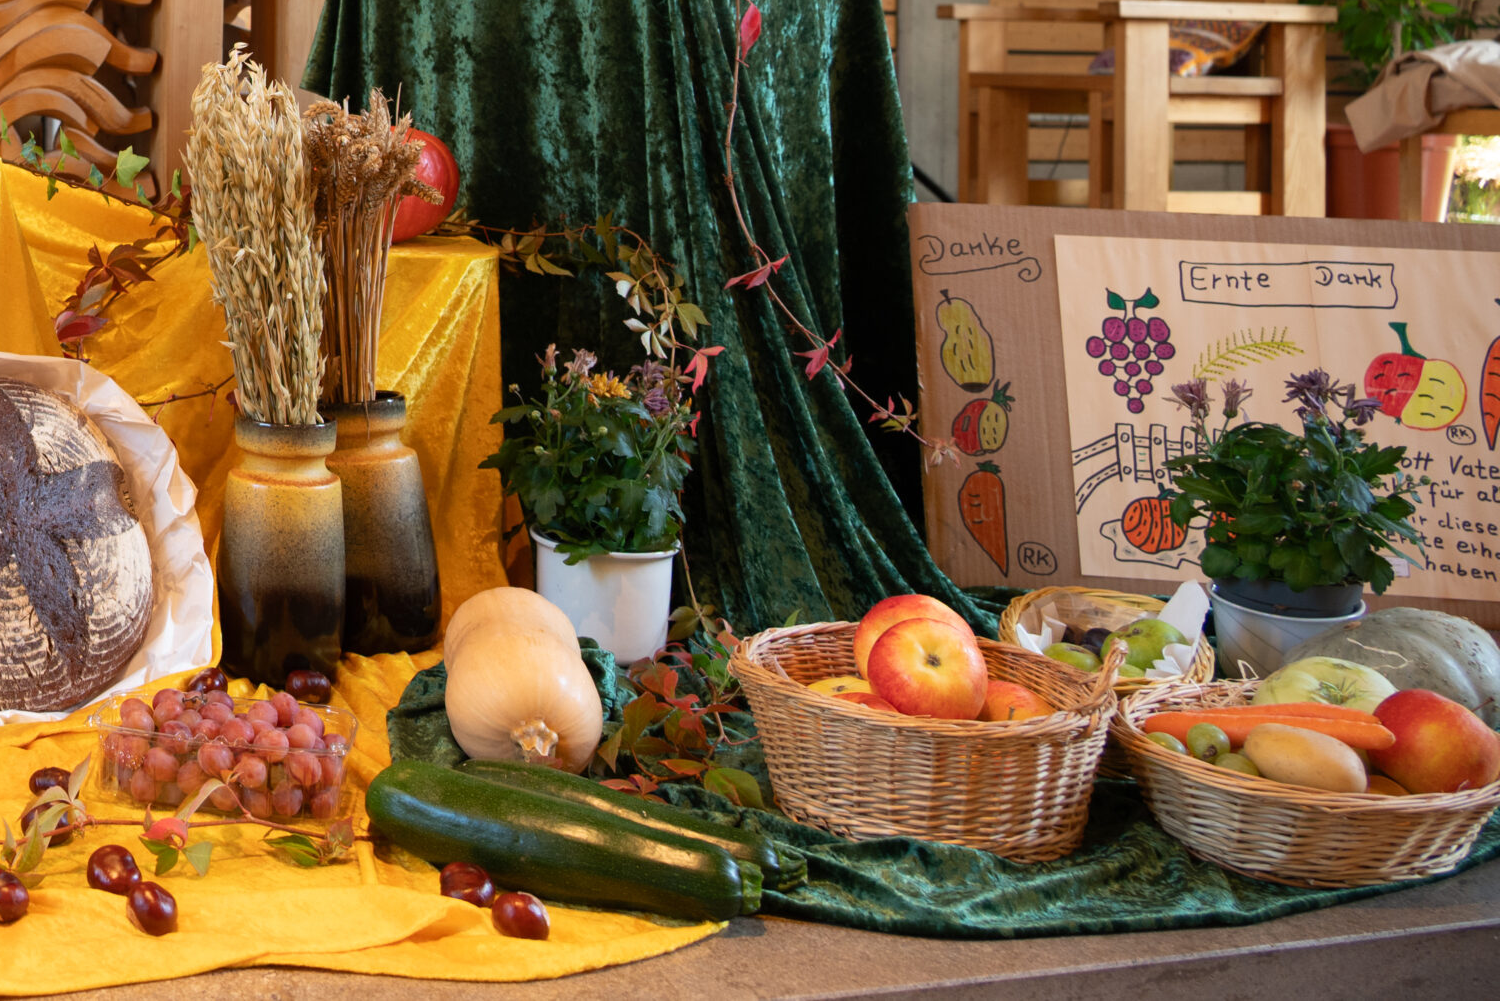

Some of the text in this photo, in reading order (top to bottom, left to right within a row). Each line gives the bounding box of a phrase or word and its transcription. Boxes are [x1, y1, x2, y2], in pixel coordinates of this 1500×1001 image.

[918, 232, 1024, 263] Danke
[1190, 266, 1382, 291] Ernte Dank
[1400, 451, 1434, 471] ott
[1429, 480, 1464, 508] für
[1438, 512, 1498, 536] diese
[1425, 554, 1498, 583] haben
